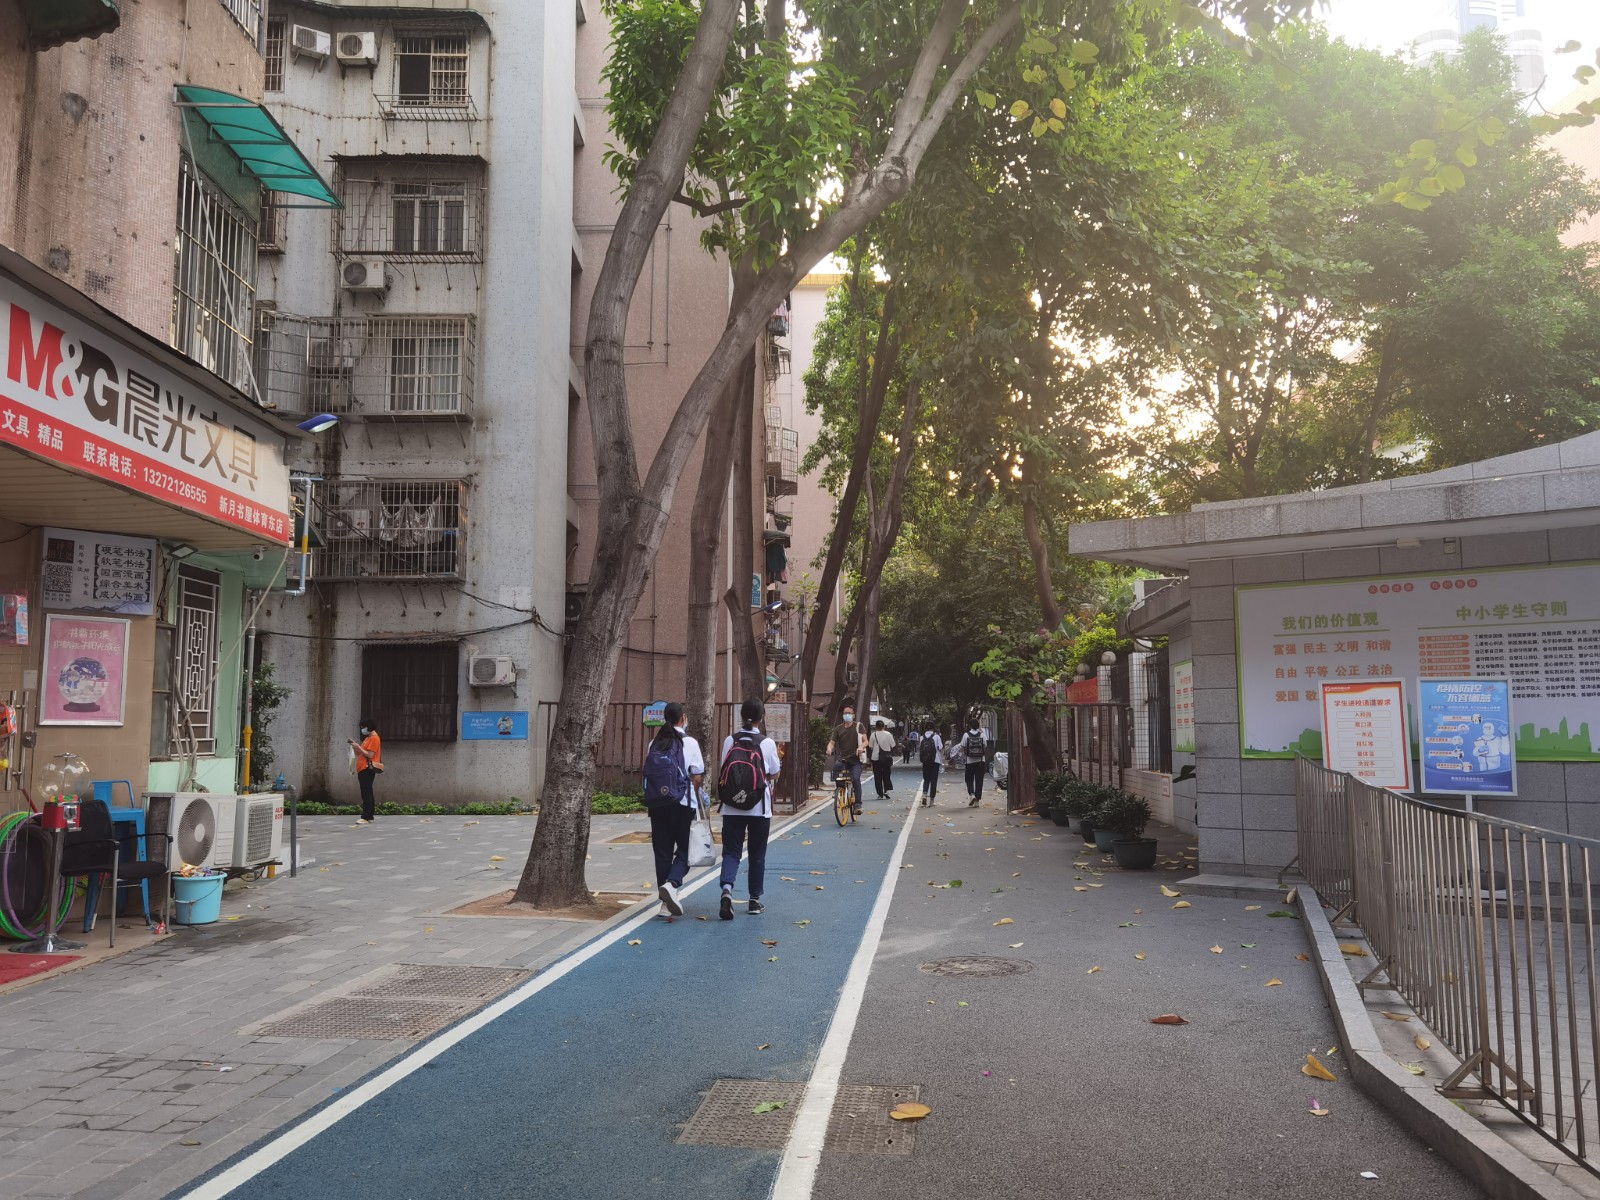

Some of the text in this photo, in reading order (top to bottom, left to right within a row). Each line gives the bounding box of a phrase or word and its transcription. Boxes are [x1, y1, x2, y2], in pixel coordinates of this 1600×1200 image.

[7, 303, 120, 427] M&G
[123, 368, 258, 492] 晨光文具
[2, 409, 30, 439] 文具
[38, 422, 64, 451] 精品
[219, 495, 284, 534] 新月书屋体育东店
[101, 546, 146, 558] 硬笔书法
[100, 557, 145, 568] 软笔书法
[100, 568, 145, 579] 国画漫画
[99, 579, 144, 590] 综合美术
[99, 590, 144, 602] 成人书画
[1456, 601, 1568, 621] 中小学生守则
[1282, 612, 1379, 630] 我们的价值观
[1273, 639, 1391, 656] 富强 民主 文明 和谐
[1275, 663, 1393, 679] 自由 平等 公正 法治
[1275, 690, 1299, 702] 爱国
[1334, 699, 1391, 707] 学生进校通道要求
